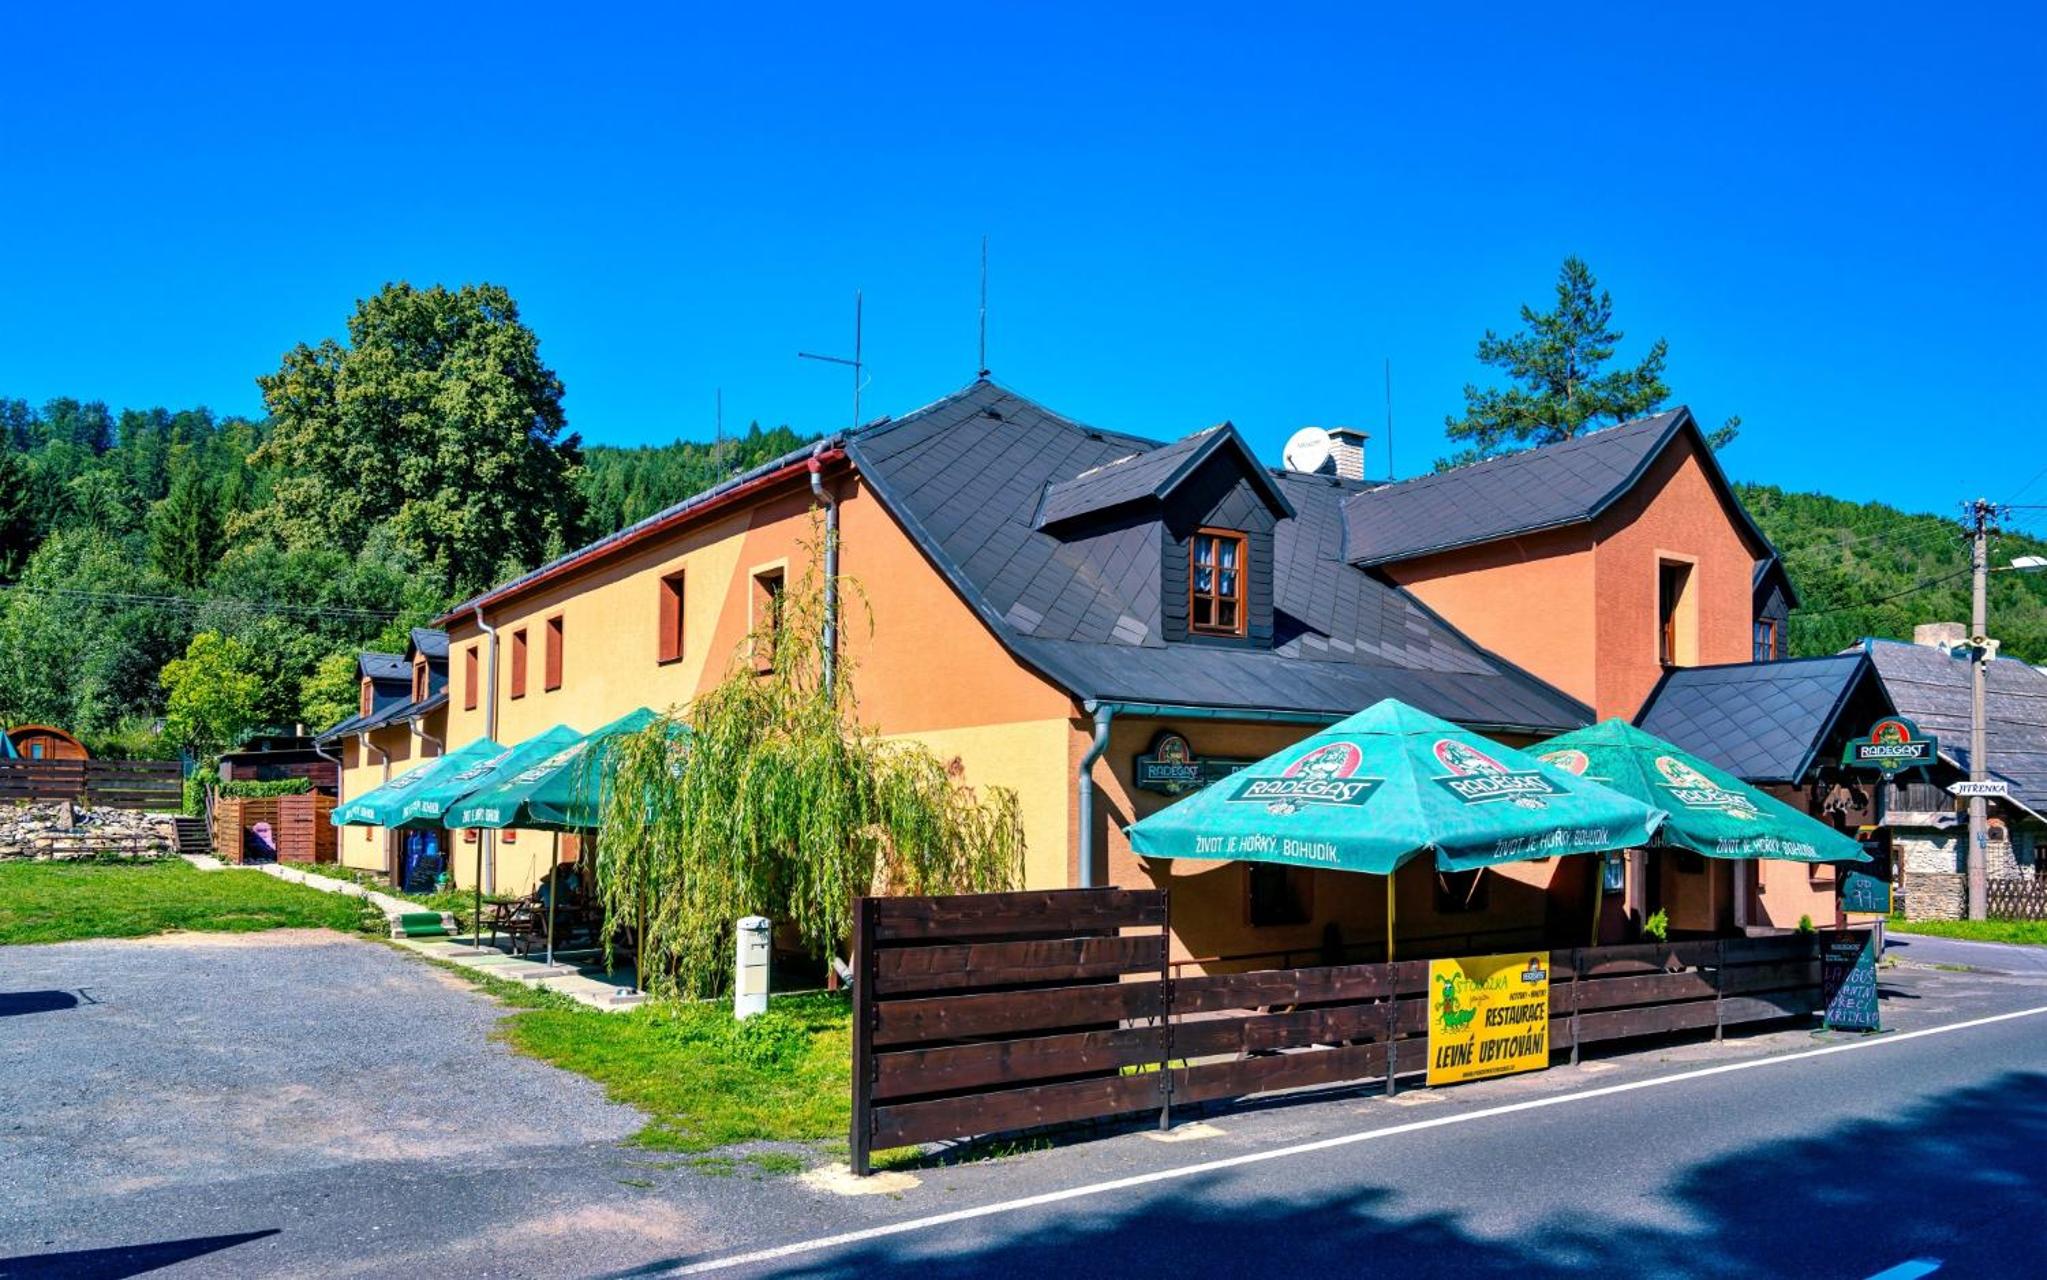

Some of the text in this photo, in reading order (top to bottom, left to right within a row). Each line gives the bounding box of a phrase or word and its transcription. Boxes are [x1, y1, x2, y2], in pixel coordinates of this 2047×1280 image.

[1861, 744, 1925, 759] RADEGAST
[1148, 765, 1199, 780] RADEGAST
[1242, 779, 1372, 802] RADEGAST
[1448, 776, 1553, 798] RADEGAST
[1959, 783, 2006, 793] JITŘENKA
[1195, 834, 1224, 853] ŽIVOT
[1227, 836, 1236, 853] JE
[1283, 839, 1341, 863] BOHUDÍK.
[1494, 838, 1525, 858] ŽIVOT
[1485, 1002, 1545, 1028] RESTAURACE
[1436, 1025, 1545, 1069] LEVNÉ UBYTOVÁNÍ
